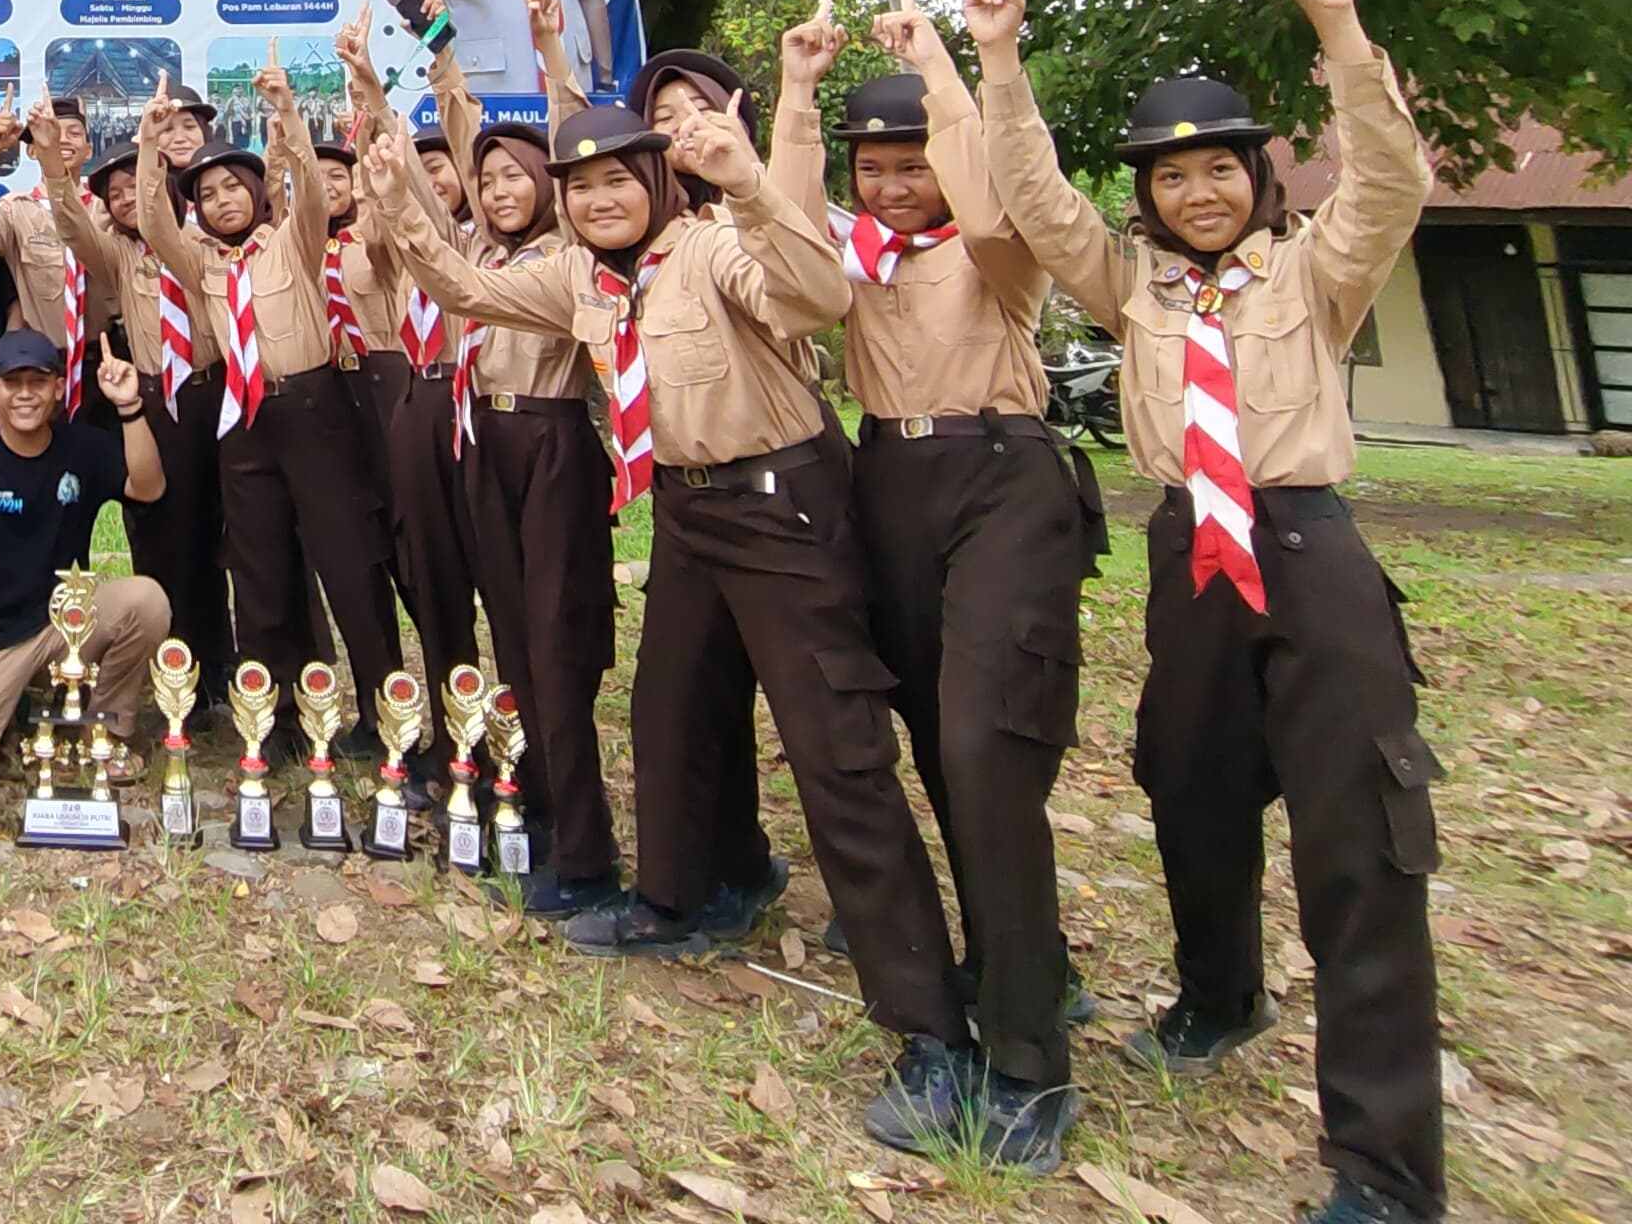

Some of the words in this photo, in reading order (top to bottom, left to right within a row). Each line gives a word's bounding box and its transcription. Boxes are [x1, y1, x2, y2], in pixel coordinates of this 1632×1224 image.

[222, 3, 239, 11] Pos
[241, 3, 262, 11] Pam
[264, 2, 302, 11] Lebaran
[303, 1, 334, 11] 1444H
